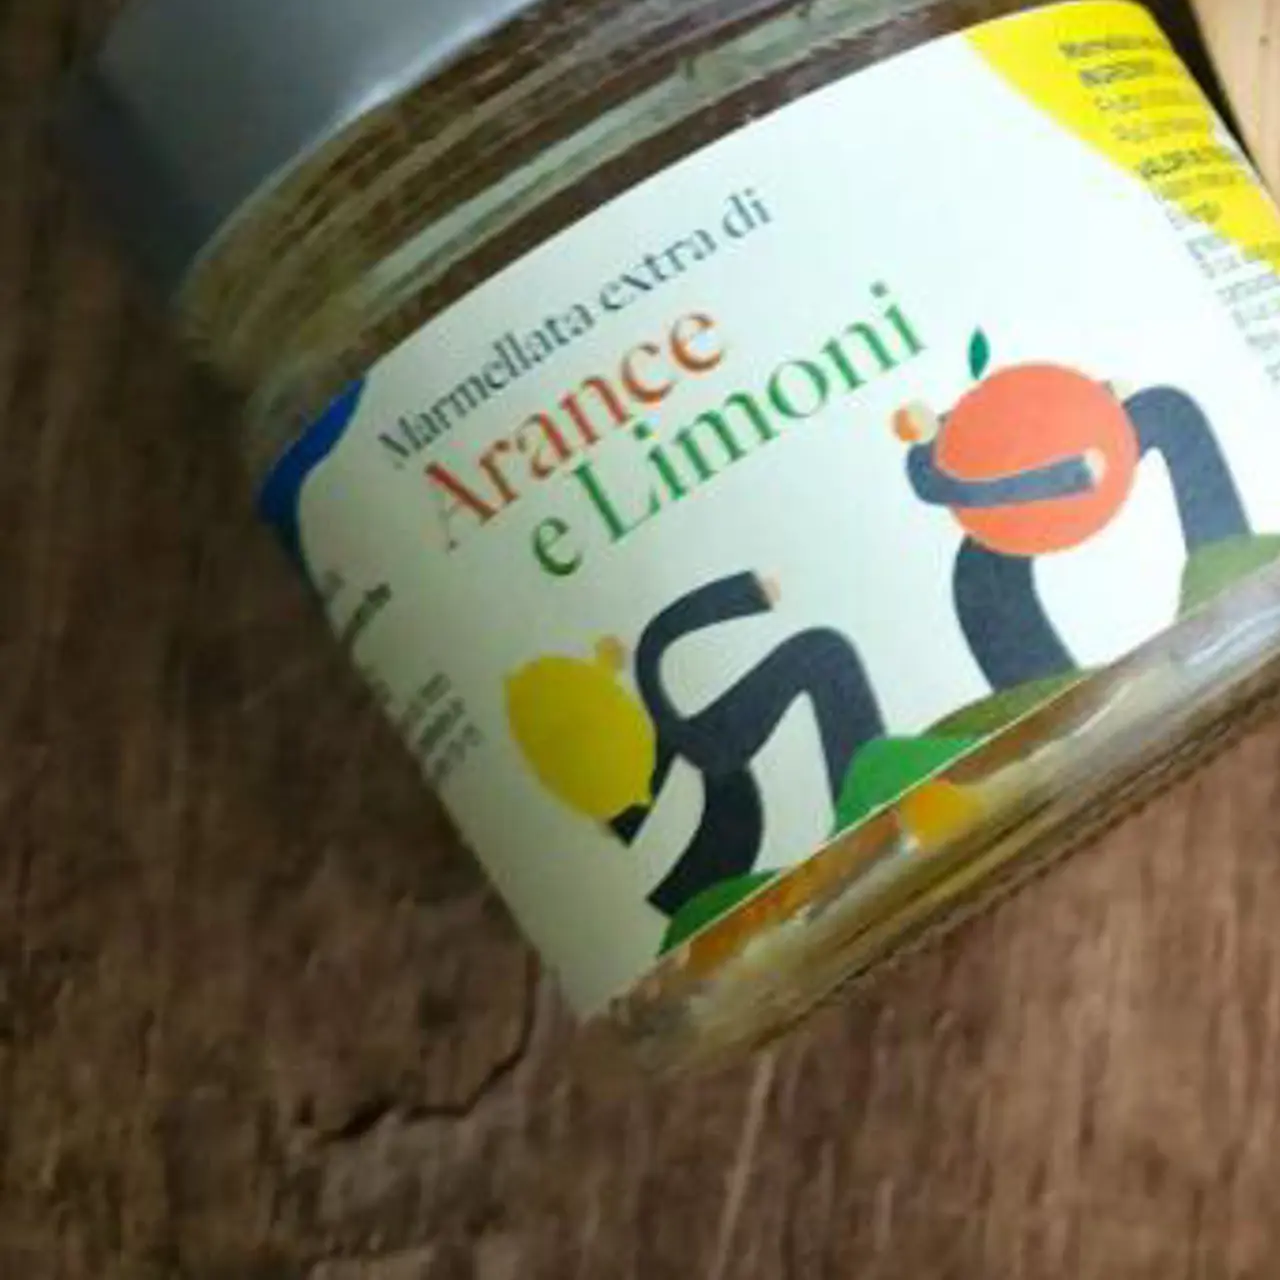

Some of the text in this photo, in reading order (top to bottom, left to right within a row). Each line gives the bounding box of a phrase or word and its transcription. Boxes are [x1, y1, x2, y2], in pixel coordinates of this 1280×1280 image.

[378, 186, 773, 469] Marmellata extra di
[423, 310, 727, 552] Arance
[530, 280, 929, 578] e Limoni
